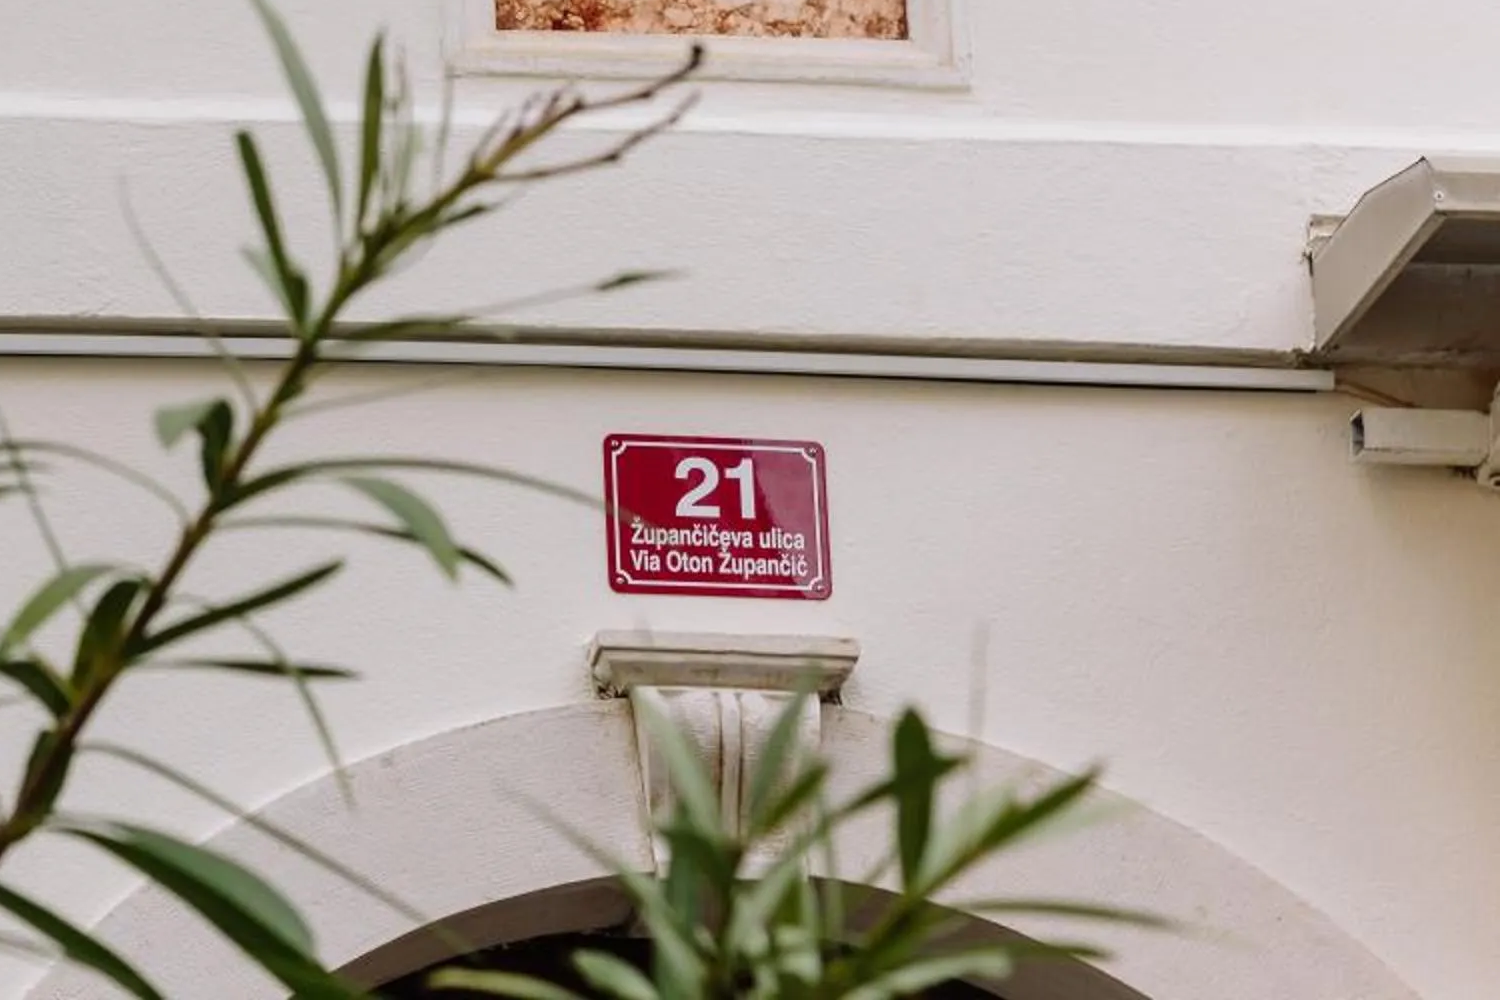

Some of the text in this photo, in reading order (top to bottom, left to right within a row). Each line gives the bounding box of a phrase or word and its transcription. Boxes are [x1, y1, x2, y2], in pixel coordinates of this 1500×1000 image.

[674, 456, 757, 519] 21
[630, 516, 806, 551] Župančičeva ulica
[629, 546, 809, 580] Via Oton Župančič
